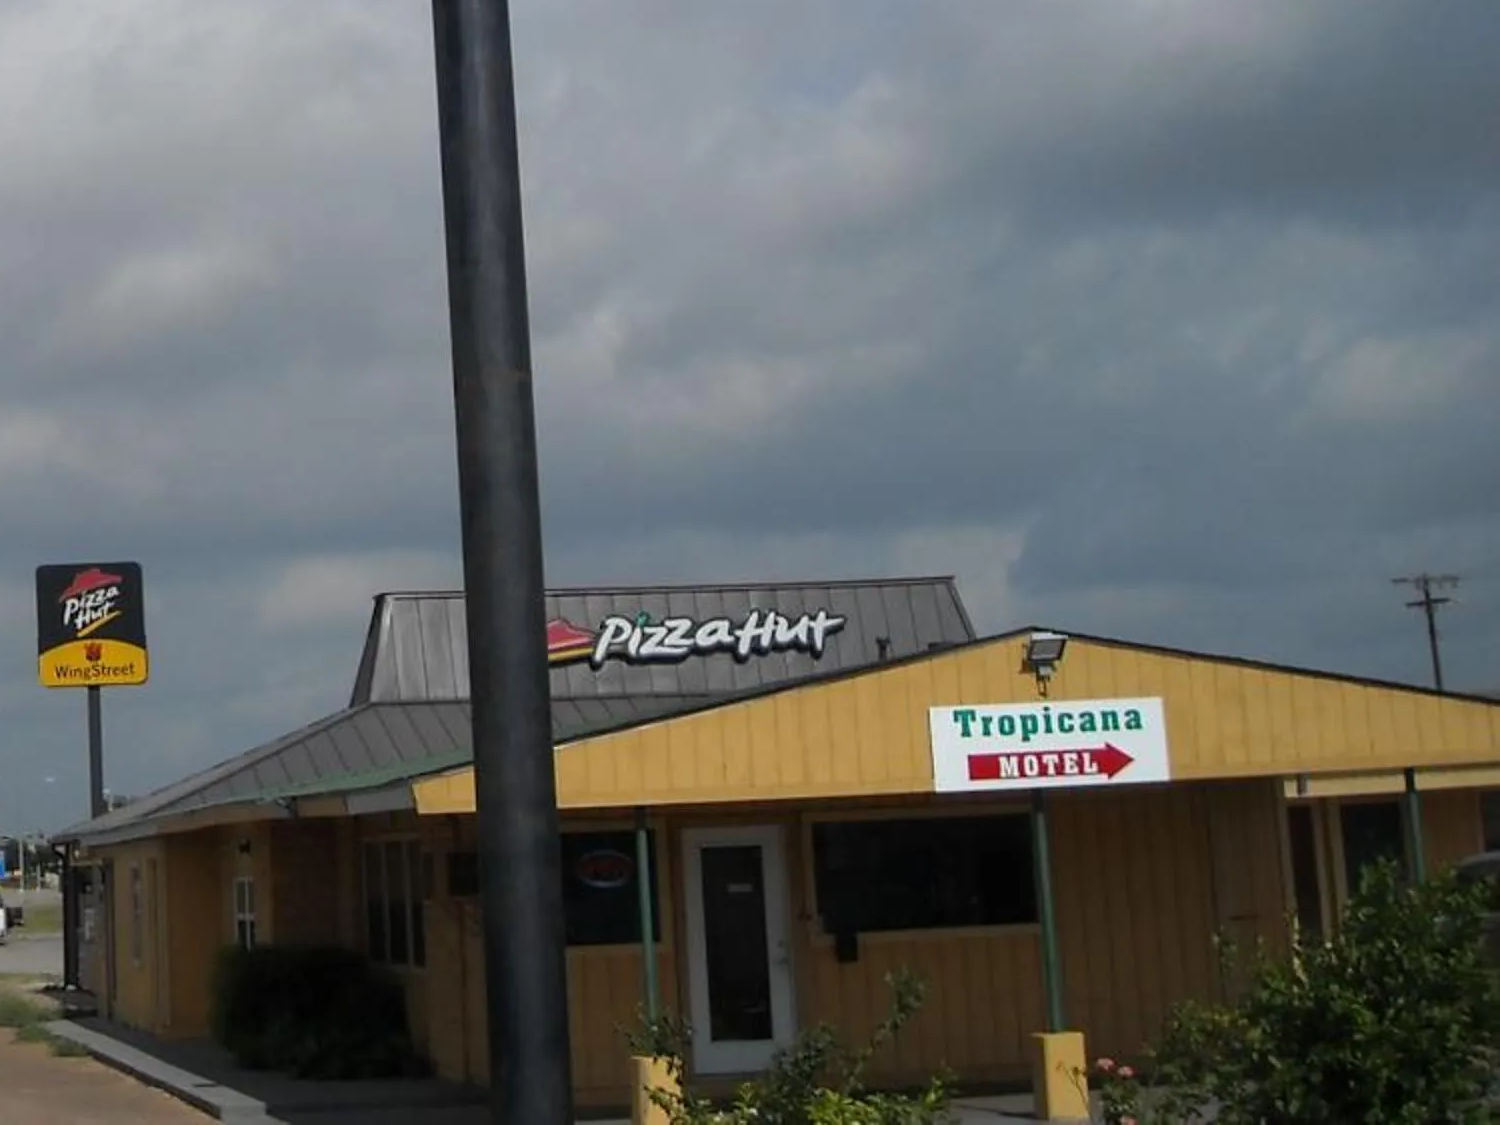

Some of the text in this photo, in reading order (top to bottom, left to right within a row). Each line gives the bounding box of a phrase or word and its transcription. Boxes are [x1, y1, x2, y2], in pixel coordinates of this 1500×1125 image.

[63, 586, 120, 626] Pizza
[75, 601, 115, 630] Hut
[593, 611, 845, 663] Pizza Hut
[55, 662, 135, 680] WingStreet
[953, 706, 1144, 742] Tropicana
[999, 752, 1098, 779] MOTEL
